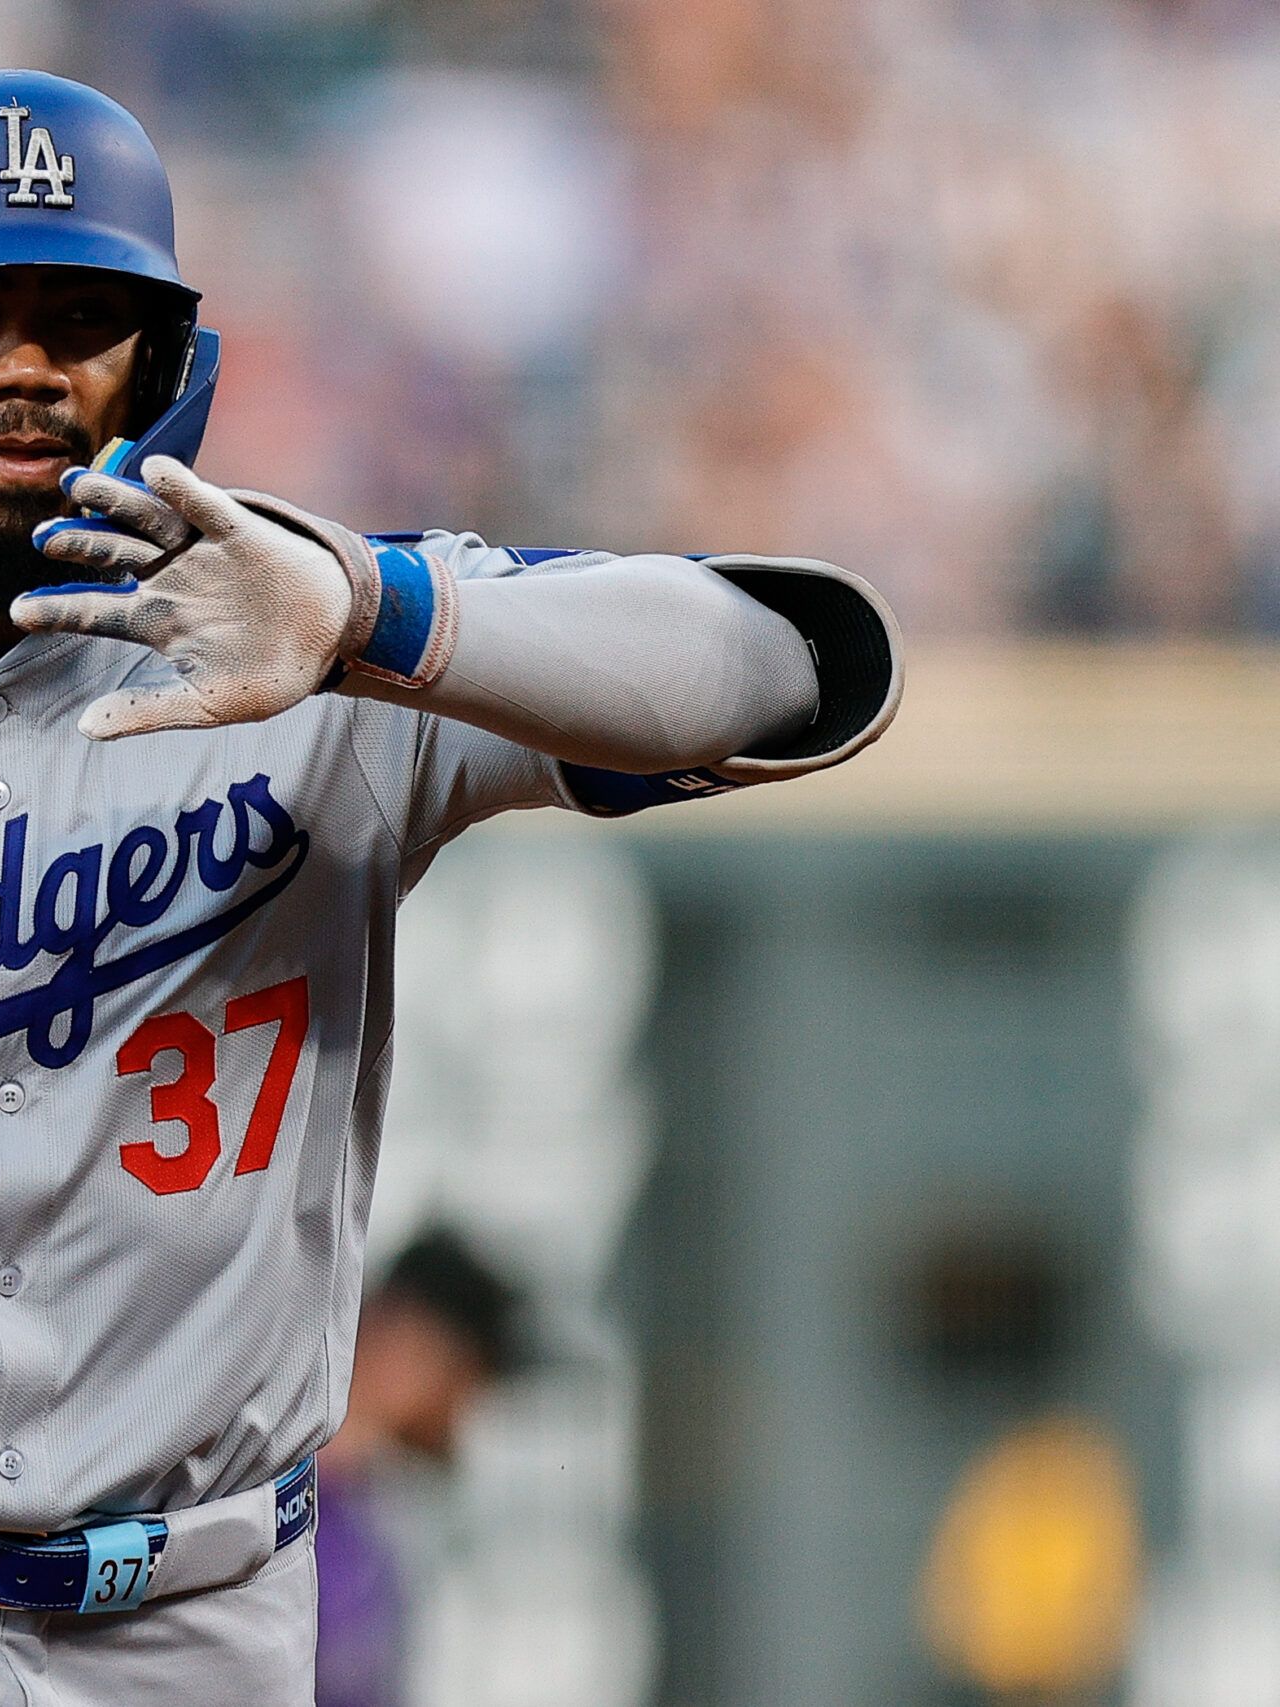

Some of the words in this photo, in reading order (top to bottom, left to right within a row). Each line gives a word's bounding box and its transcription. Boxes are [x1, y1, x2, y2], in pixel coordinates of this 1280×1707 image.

[116, 975, 310, 1196] 37
[276, 1486, 312, 1529] NOK
[94, 1557, 144, 1605] 37
